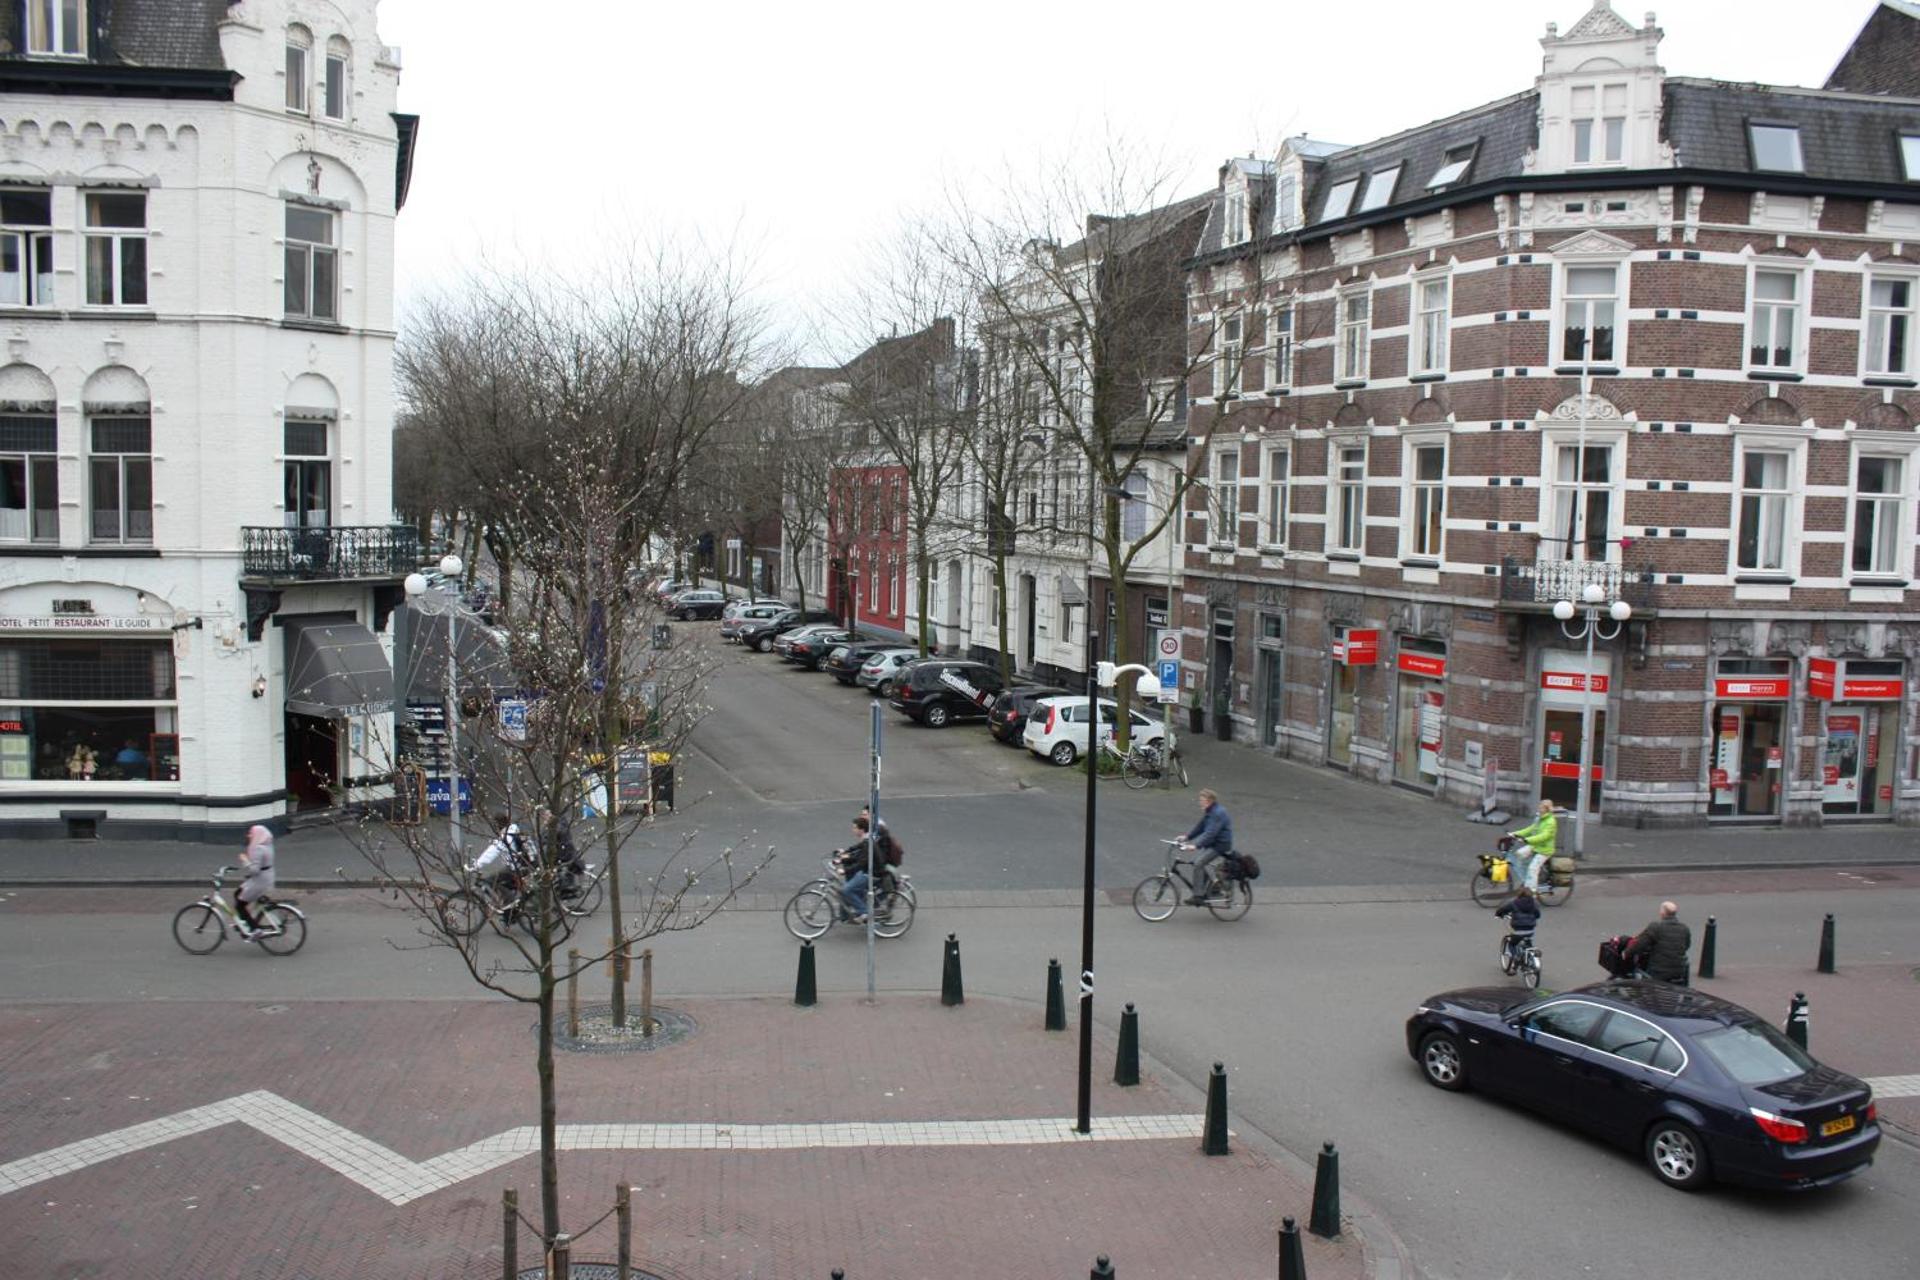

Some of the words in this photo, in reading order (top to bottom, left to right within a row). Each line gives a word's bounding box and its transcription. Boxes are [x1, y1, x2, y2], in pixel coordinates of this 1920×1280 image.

[0, 618, 22, 628] OTEL
[54, 618, 110, 628] RESTAURANT
[114, 618, 124, 628] LE
[125, 618, 151, 628] GUIDE
[1163, 663, 1175, 678] P
[425, 791, 467, 801] avaa
